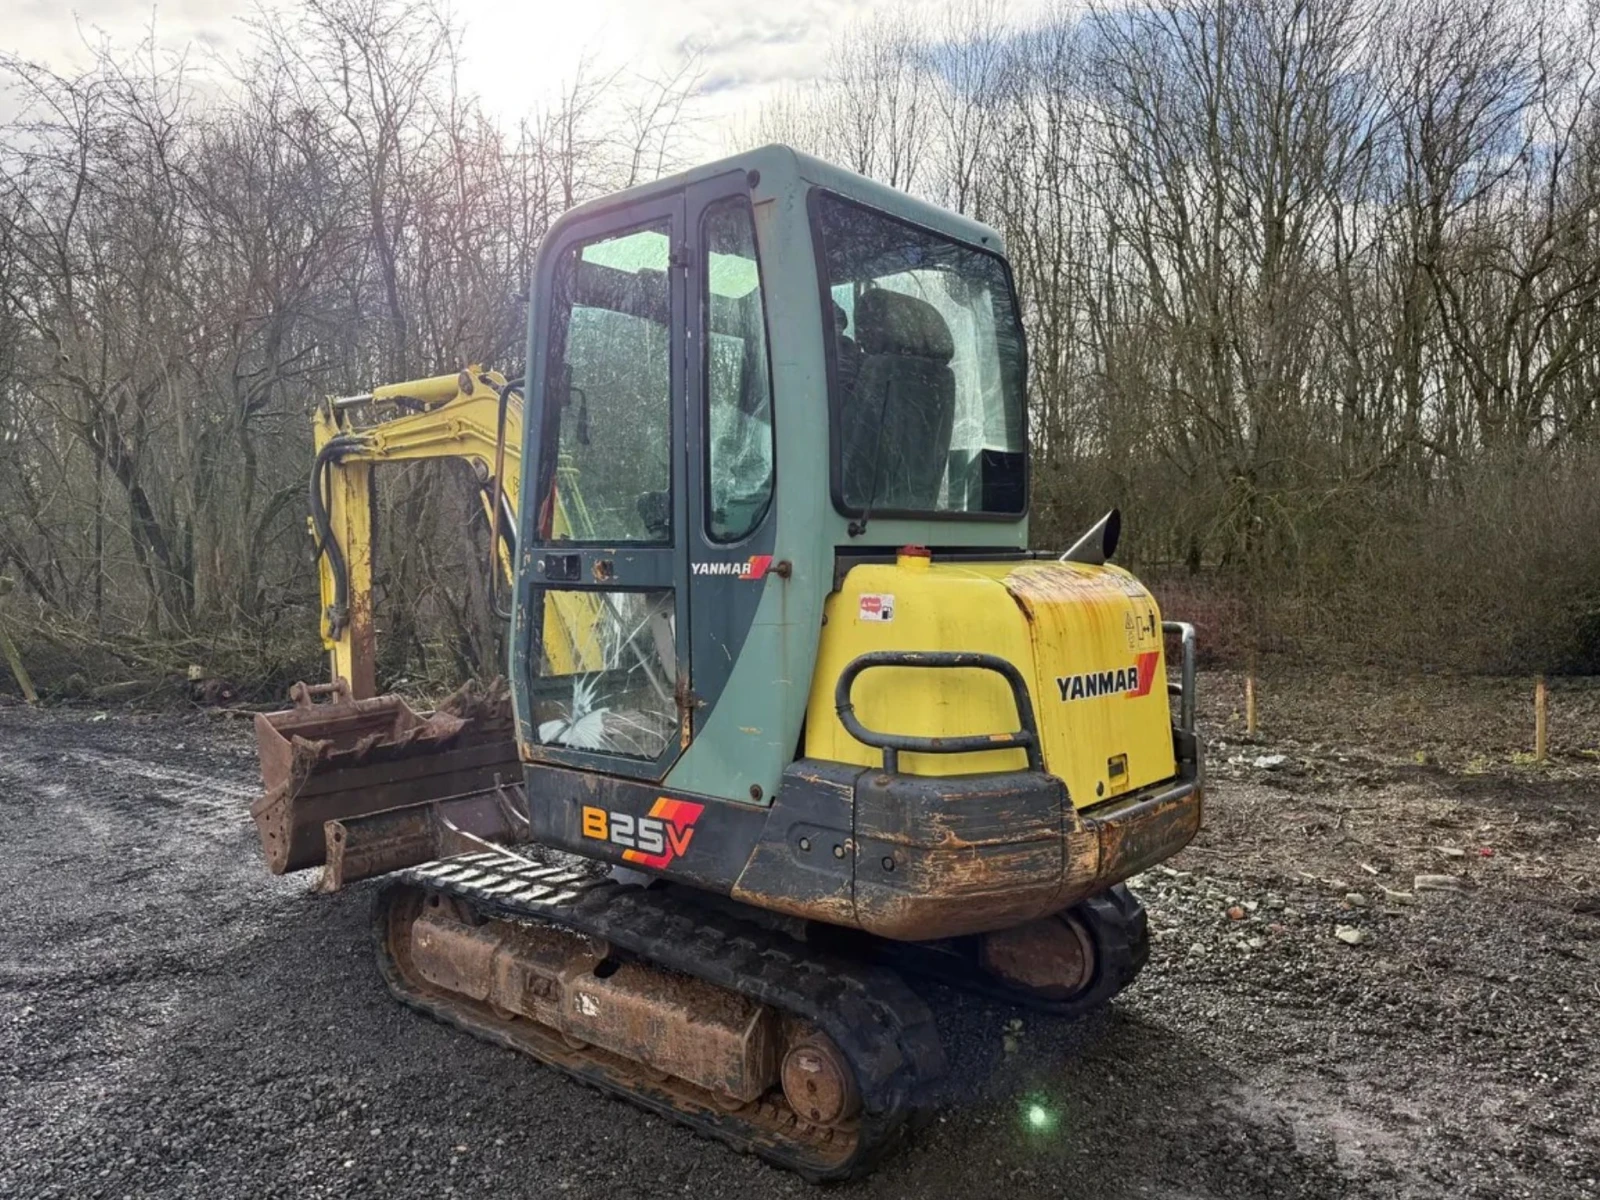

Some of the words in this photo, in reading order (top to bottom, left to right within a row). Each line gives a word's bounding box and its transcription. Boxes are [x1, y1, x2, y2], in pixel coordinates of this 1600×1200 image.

[691, 562, 751, 575] YANMAR
[1056, 667, 1139, 702] YANMAR
[582, 805, 695, 857] B25V
